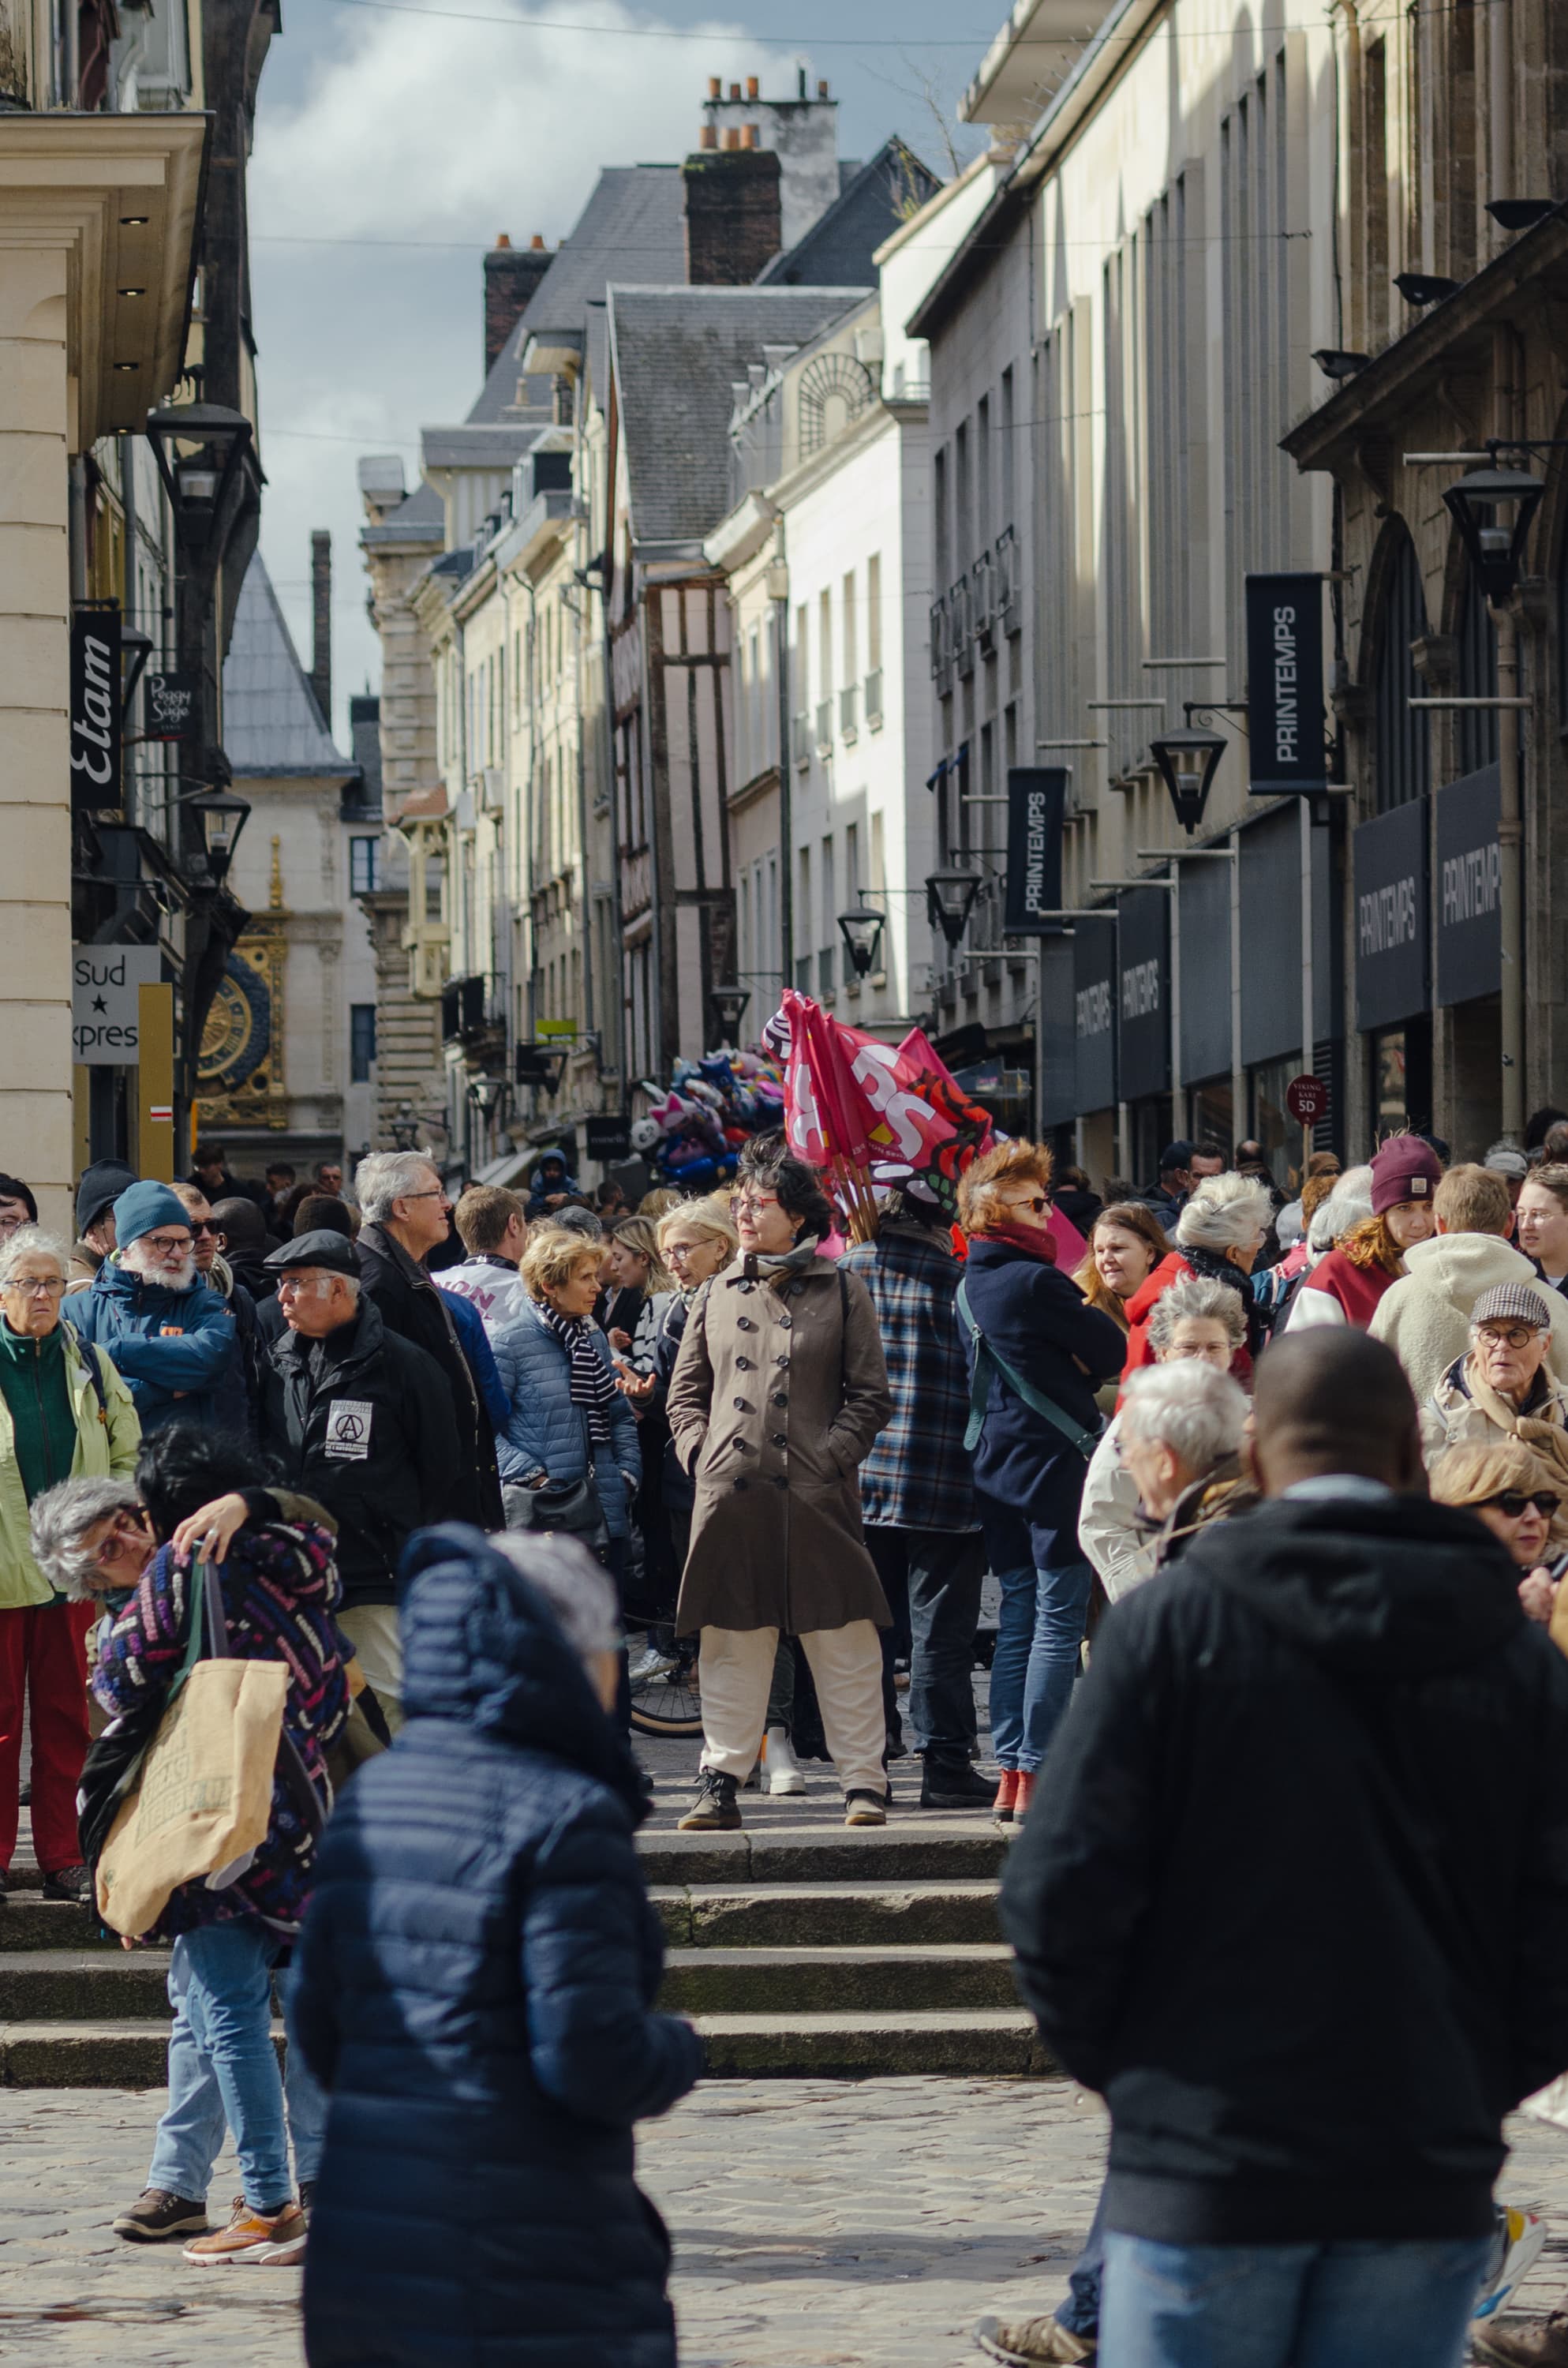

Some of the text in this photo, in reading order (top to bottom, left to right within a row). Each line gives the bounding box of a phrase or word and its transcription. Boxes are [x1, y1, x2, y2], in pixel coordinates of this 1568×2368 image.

[70, 635, 112, 784] Etam
[151, 676, 191, 706] Peggy
[151, 700, 189, 723] Sage
[1274, 606, 1298, 762] PRINTEMPS
[1026, 792, 1046, 912] PRINTEMPS
[1443, 842, 1499, 927] PRINTEMP
[1360, 875, 1416, 957] PRINTEMPS
[75, 954, 125, 986] Sud
[1293, 1083, 1322, 1092] VIKING
